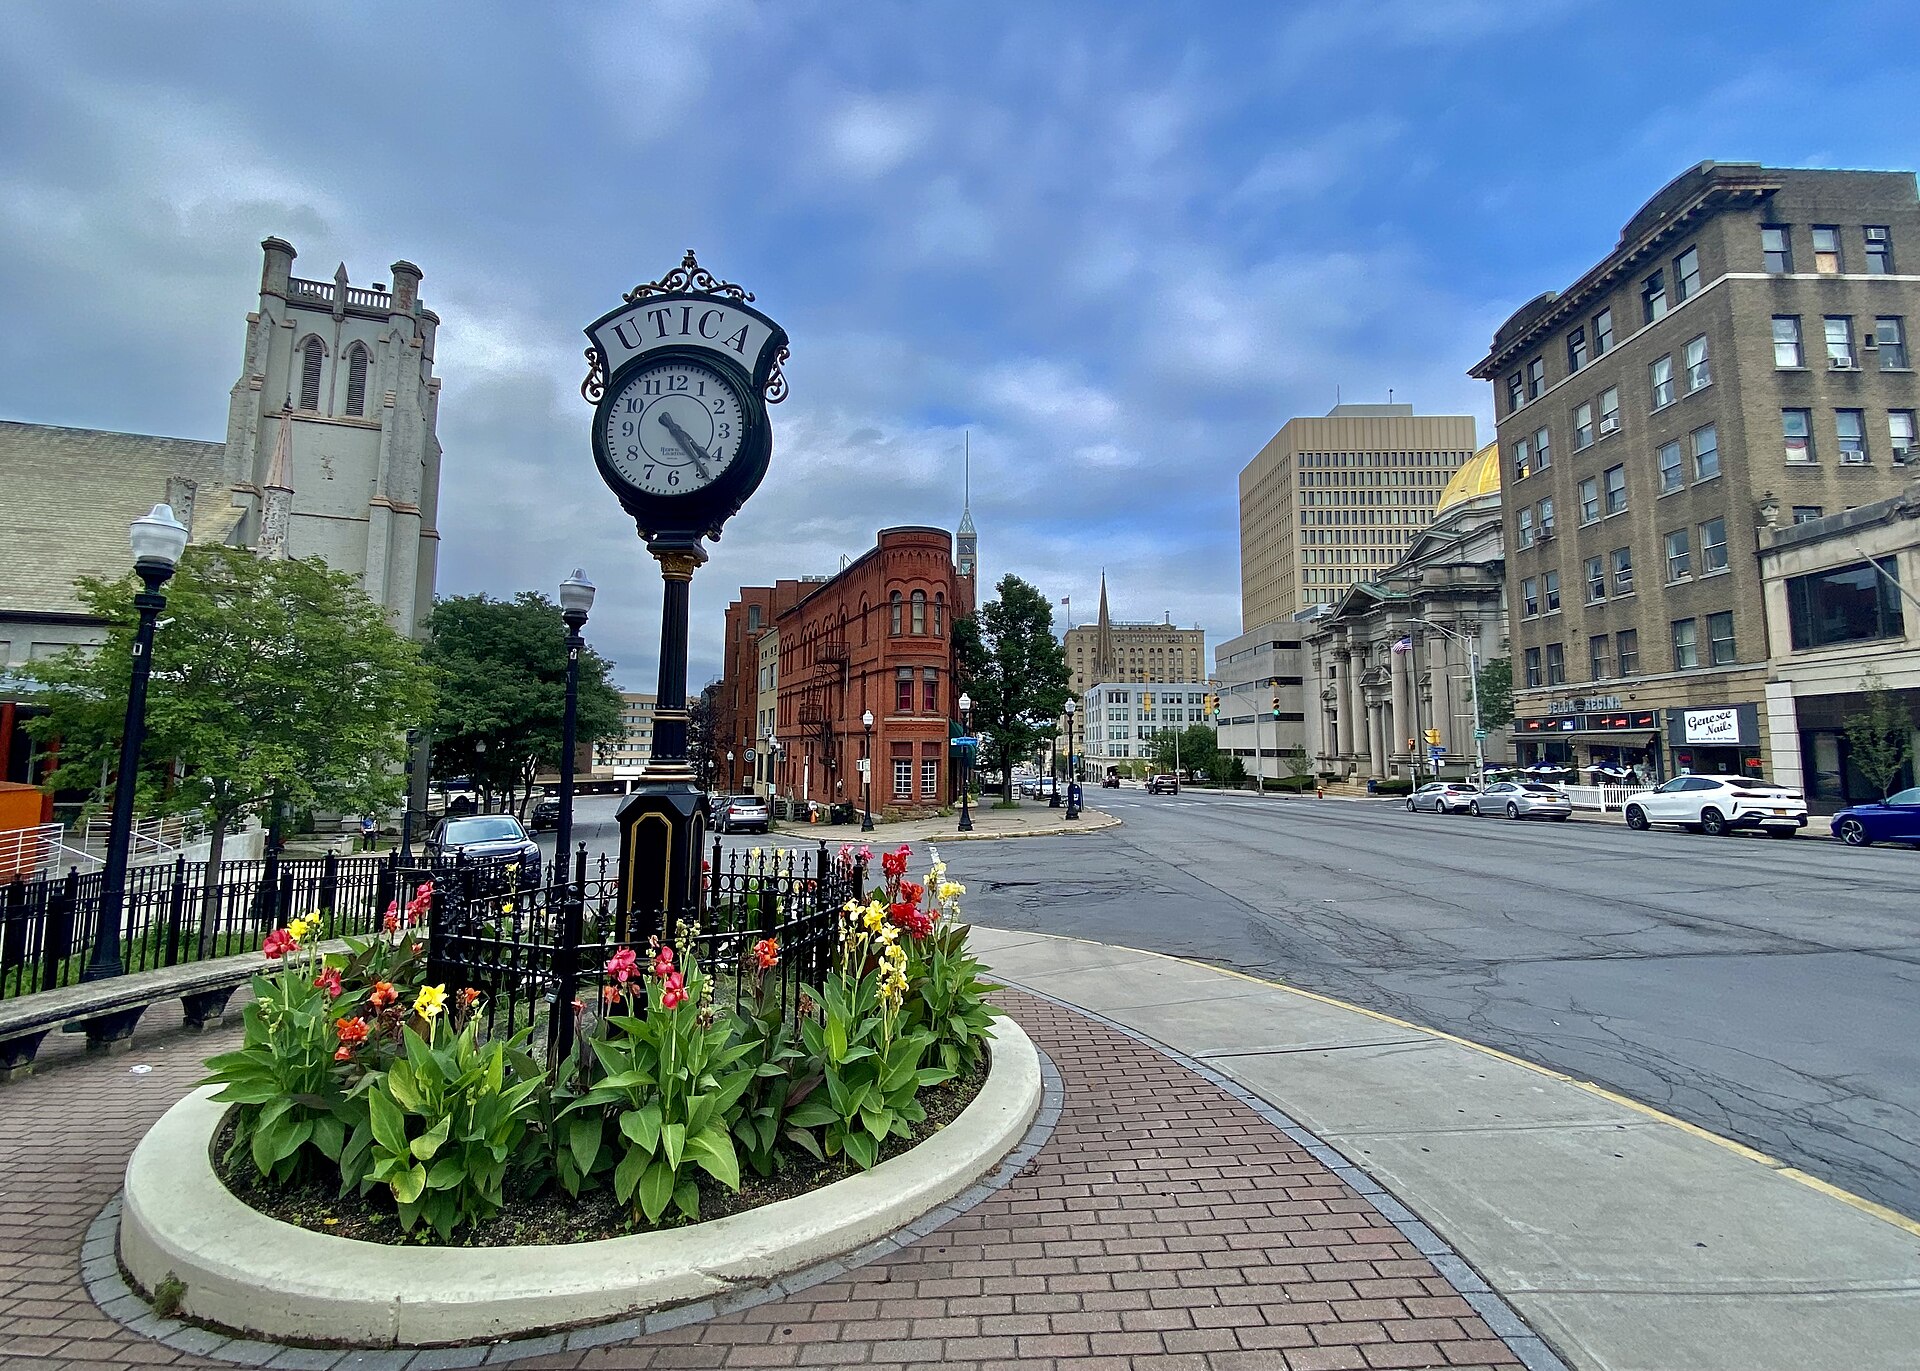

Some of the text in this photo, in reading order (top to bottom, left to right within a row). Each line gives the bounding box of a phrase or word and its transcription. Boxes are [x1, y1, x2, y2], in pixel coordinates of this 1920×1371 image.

[610, 306, 751, 355] UTICA
[643, 379, 662, 395] 11
[666, 375, 688, 391] 12
[696, 381, 706, 397] 1
[624, 398, 644, 414] 10
[713, 398, 726, 414] 2
[622, 421, 634, 437] 9
[718, 423, 730, 439] 3
[626, 445, 639, 461] 8
[711, 446, 724, 462] 4
[643, 464, 656, 480] 7
[667, 470, 680, 486] 6
[1547, 696, 1623, 714] BELLA REGINA
[1688, 711, 1732, 731] Genesee
[1705, 721, 1732, 735] Nails
